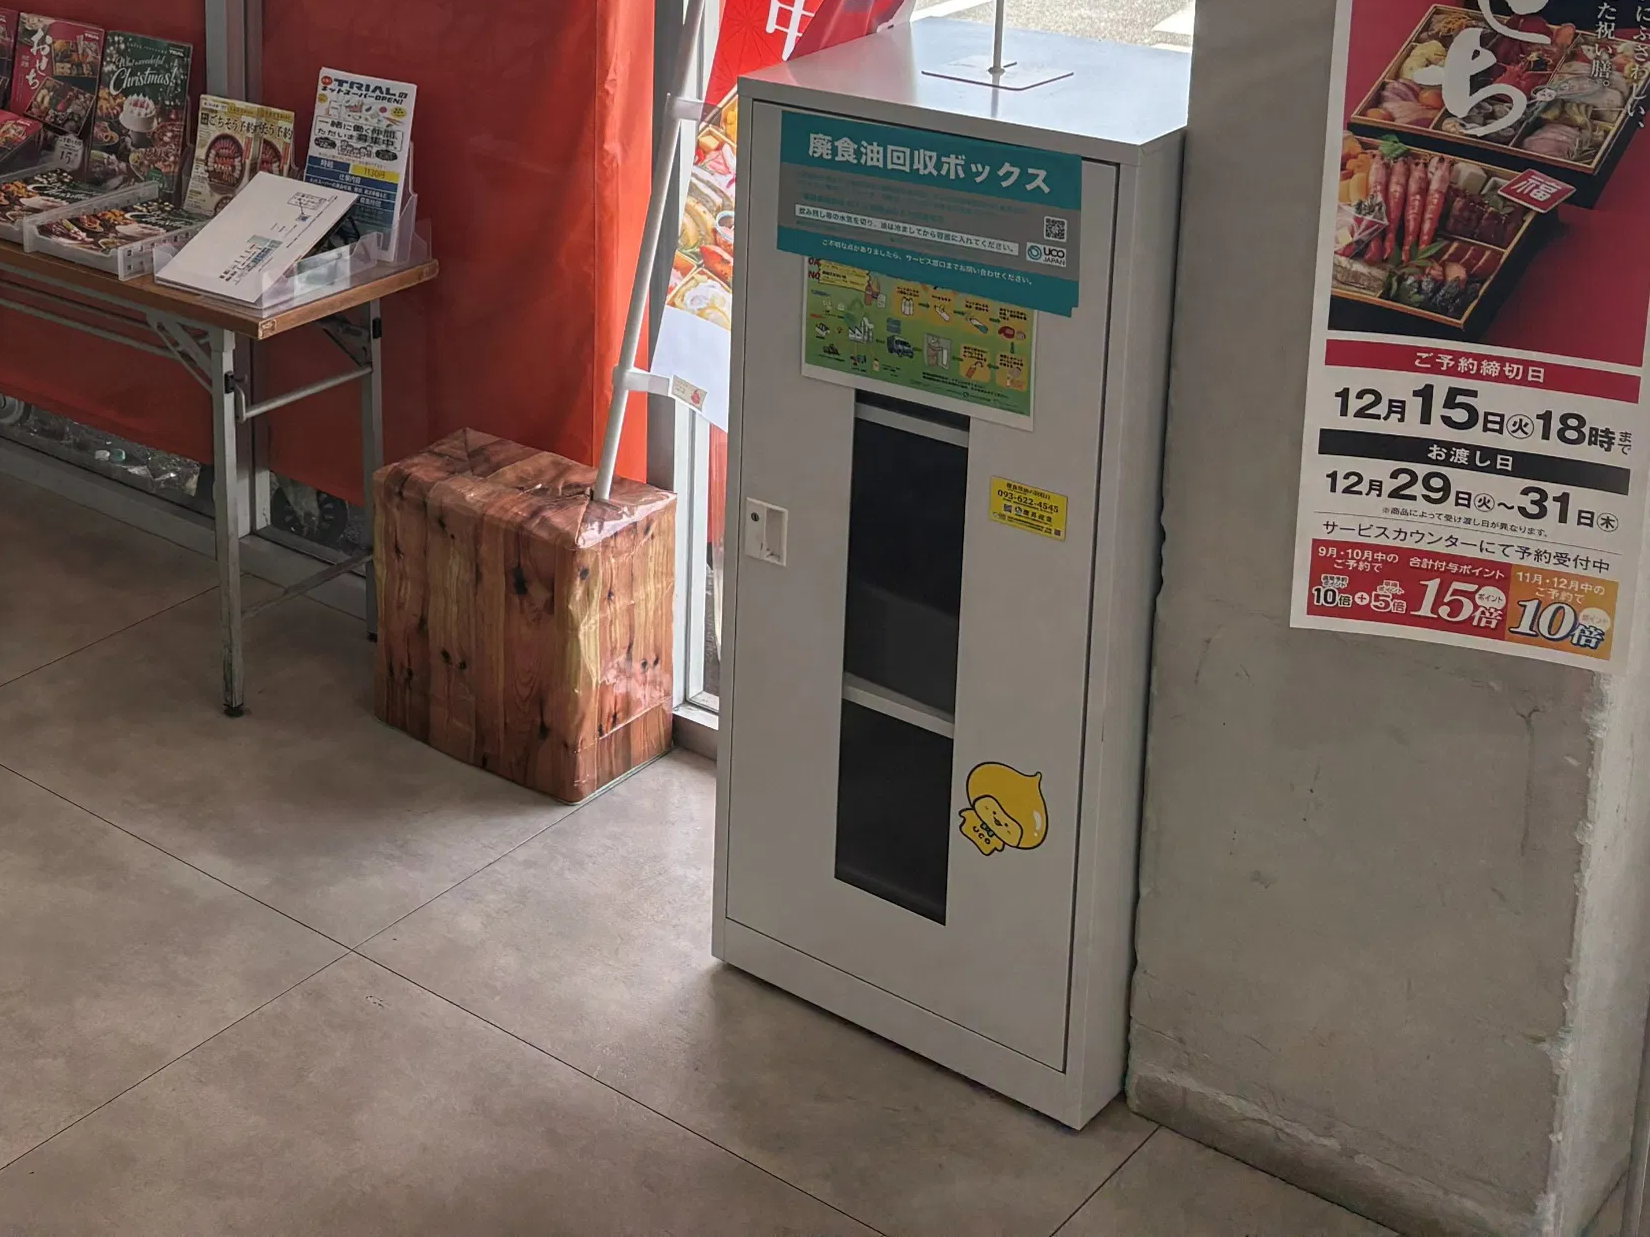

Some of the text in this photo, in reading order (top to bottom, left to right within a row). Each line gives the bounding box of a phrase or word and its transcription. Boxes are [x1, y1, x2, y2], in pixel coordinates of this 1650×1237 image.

[26, 28, 53, 90] おせち
[109, 66, 179, 96] Christmas!
[334, 78, 408, 99] TRIALの
[808, 133, 1051, 194] 廃食油回収ボックス
[1043, 246, 1065, 258] UCO
[1414, 352, 1545, 383] ご予約締切日
[1427, 444, 1514, 472] お渡し日
[997, 489, 1059, 513] 093-622-4545
[1323, 519, 1610, 574] サービスカウンターにて予約受付中
[1334, 559, 1383, 573] ご予約で
[1409, 556, 1505, 580] 合計付与ポイント
[1313, 586, 1353, 607] 10倍
